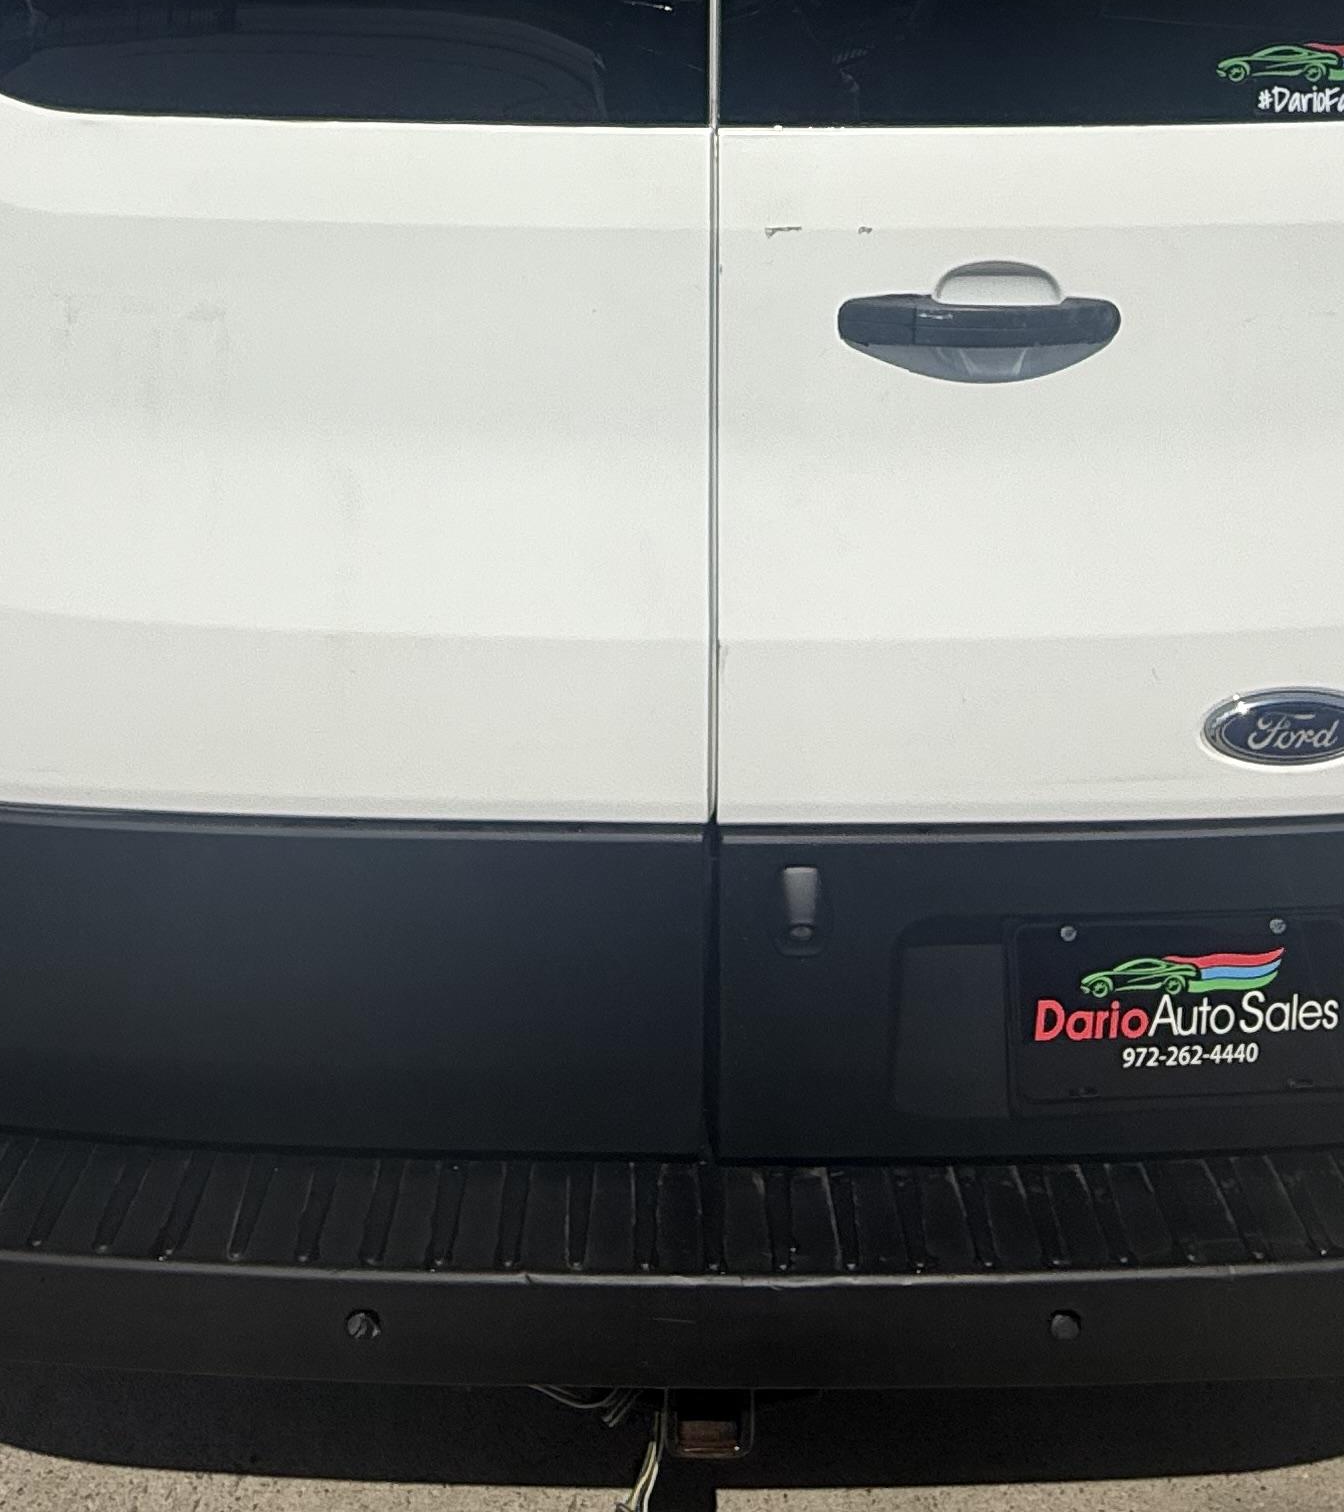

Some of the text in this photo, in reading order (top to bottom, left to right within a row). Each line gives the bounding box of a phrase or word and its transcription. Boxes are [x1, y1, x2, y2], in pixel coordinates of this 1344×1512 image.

[1248, 712, 1338, 749] Ford
[1240, 990, 1339, 1034] Sales
[1122, 1042, 1259, 1068] 972-262-4440
